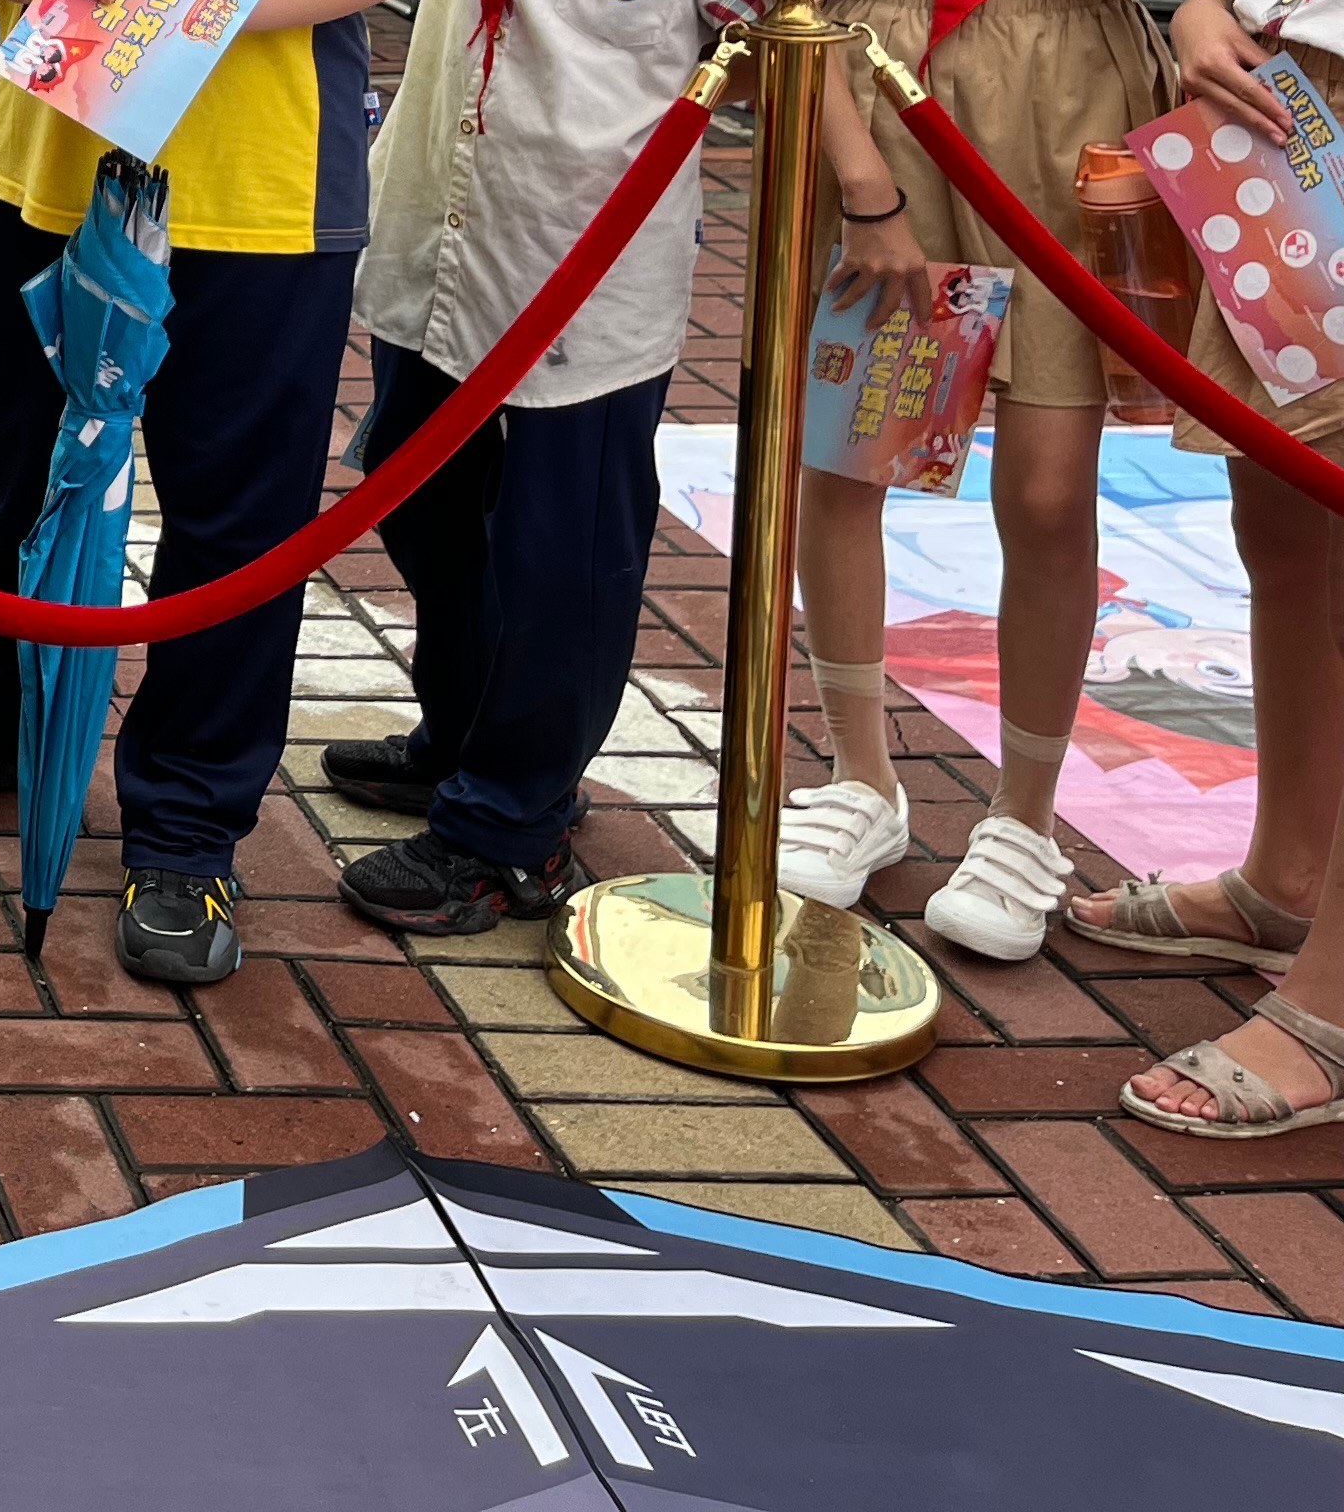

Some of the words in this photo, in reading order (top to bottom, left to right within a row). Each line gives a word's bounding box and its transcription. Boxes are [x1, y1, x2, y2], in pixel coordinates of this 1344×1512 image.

[1272, 70, 1335, 150] 小灯塔
[1285, 131, 1323, 192] 闯关
[454, 1397, 508, 1448] 左
[626, 1391, 697, 1458] LEFT
